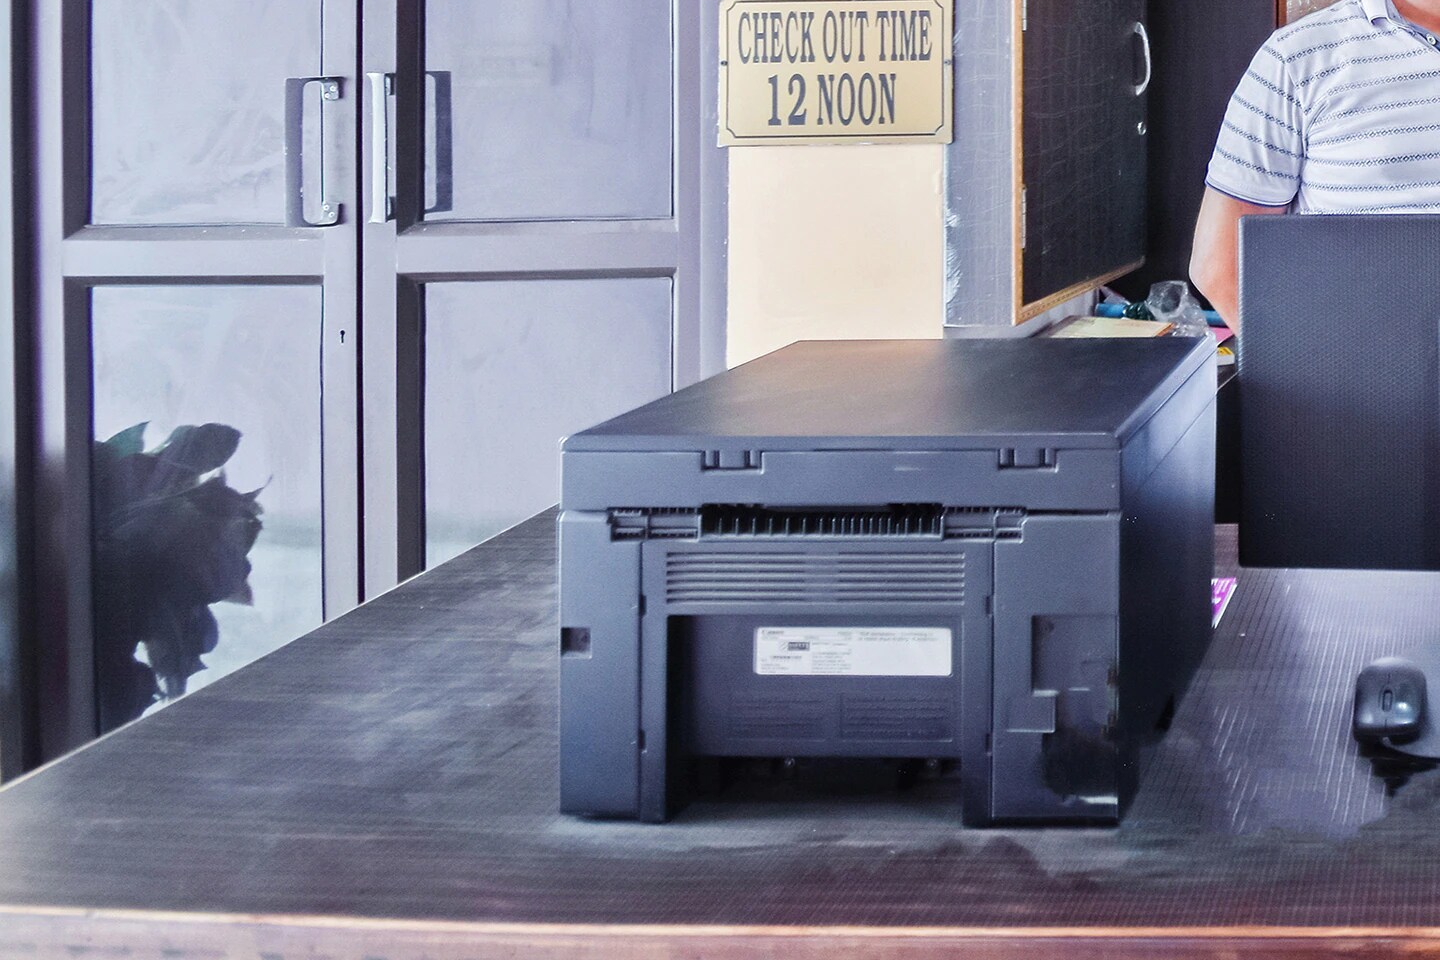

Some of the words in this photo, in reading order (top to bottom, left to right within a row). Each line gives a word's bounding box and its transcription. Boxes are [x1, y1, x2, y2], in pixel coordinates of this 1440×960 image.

[737, 11, 816, 65] CHECK
[822, 10, 870, 64] OUT
[875, 10, 932, 62] TIME
[767, 73, 807, 126] 12
[816, 72, 896, 126] NOON
